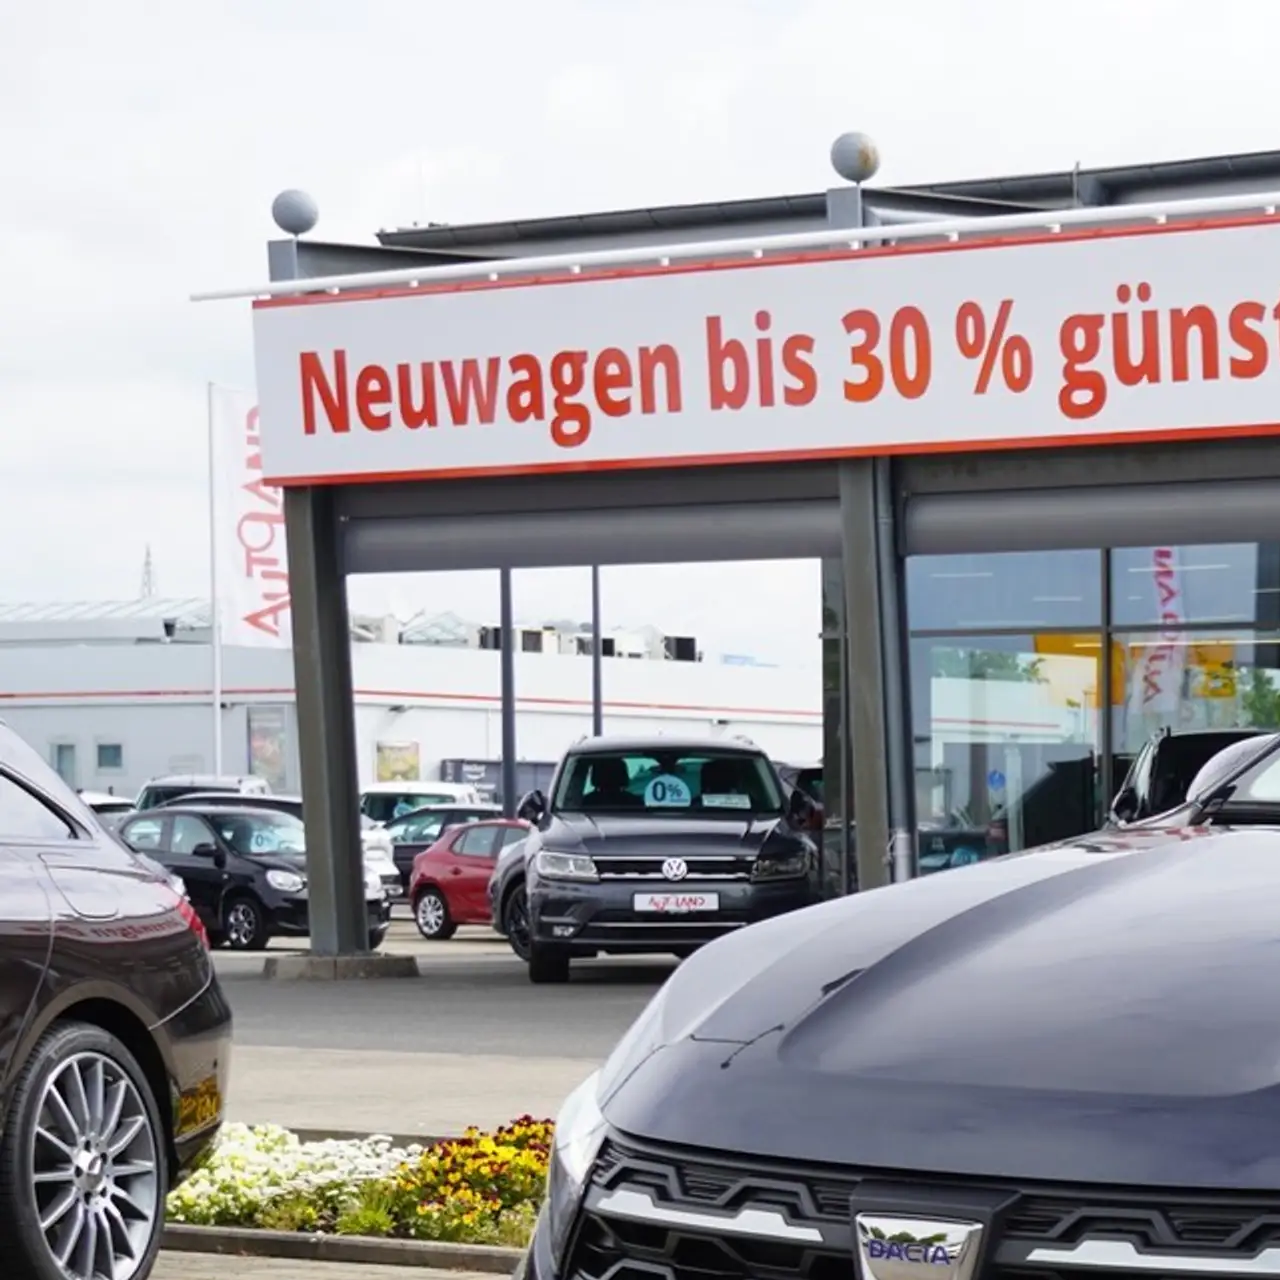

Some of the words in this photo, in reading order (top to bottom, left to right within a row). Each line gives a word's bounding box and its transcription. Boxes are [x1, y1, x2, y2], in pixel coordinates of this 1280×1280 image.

[299, 344, 682, 448] Neuwagen
[706, 310, 818, 410] bis
[842, 305, 932, 404] 30
[955, 298, 1034, 394] %
[652, 780, 684, 803] 0%
[868, 1238, 951, 1266] DACIA
